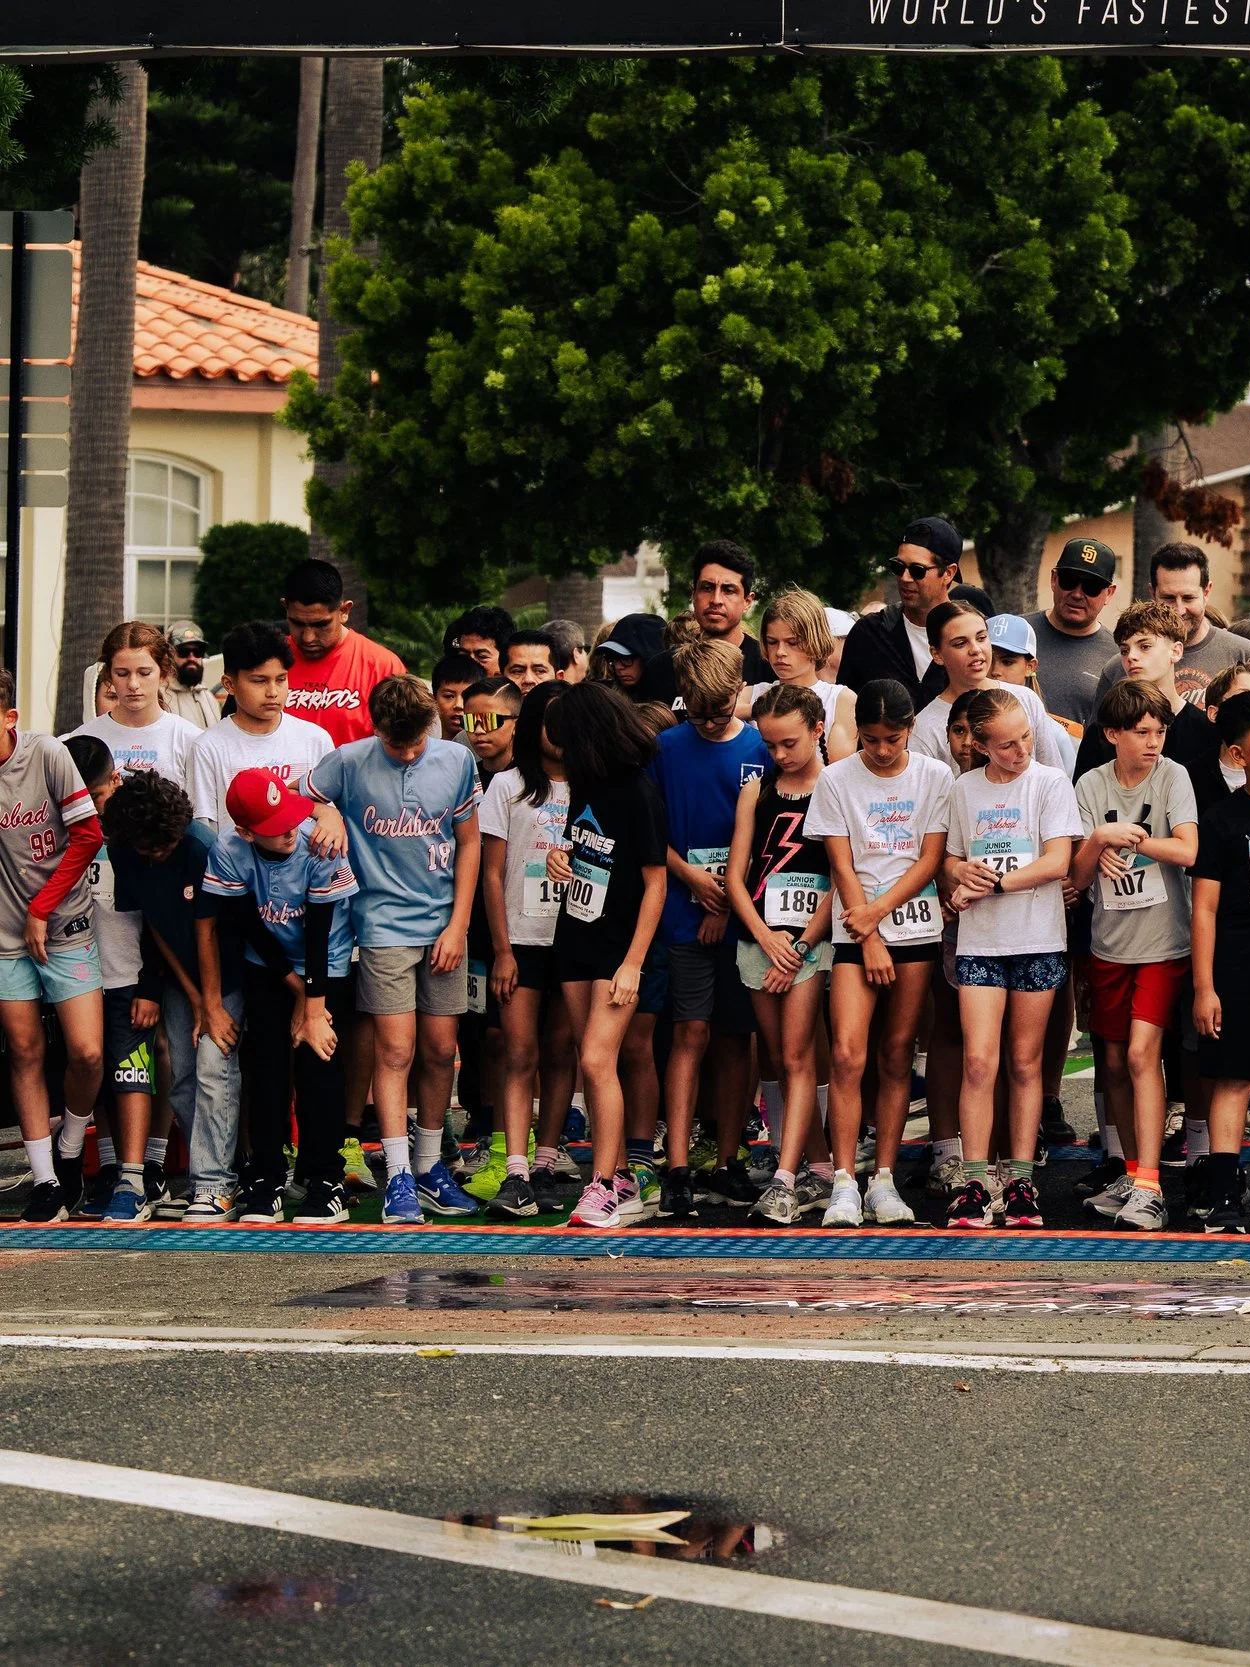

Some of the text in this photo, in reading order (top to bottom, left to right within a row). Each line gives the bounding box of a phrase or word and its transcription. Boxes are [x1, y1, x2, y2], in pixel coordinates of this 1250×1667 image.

[869, 0, 1048, 25] WORLD'S
[1077, 0, 1250, 25] FASTEST
[114, 750, 158, 761] JUNIOR
[868, 801, 914, 813] JUNIOR
[978, 808, 1021, 822] JUNIOR
[30, 827, 57, 862] 99
[985, 842, 1012, 850] JUNIOR
[427, 842, 450, 872] 18
[786, 876, 815, 884] JUNIOR
[1111, 870, 1145, 897] 107
[780, 890, 818, 914] 189
[891, 900, 932, 926] 648
